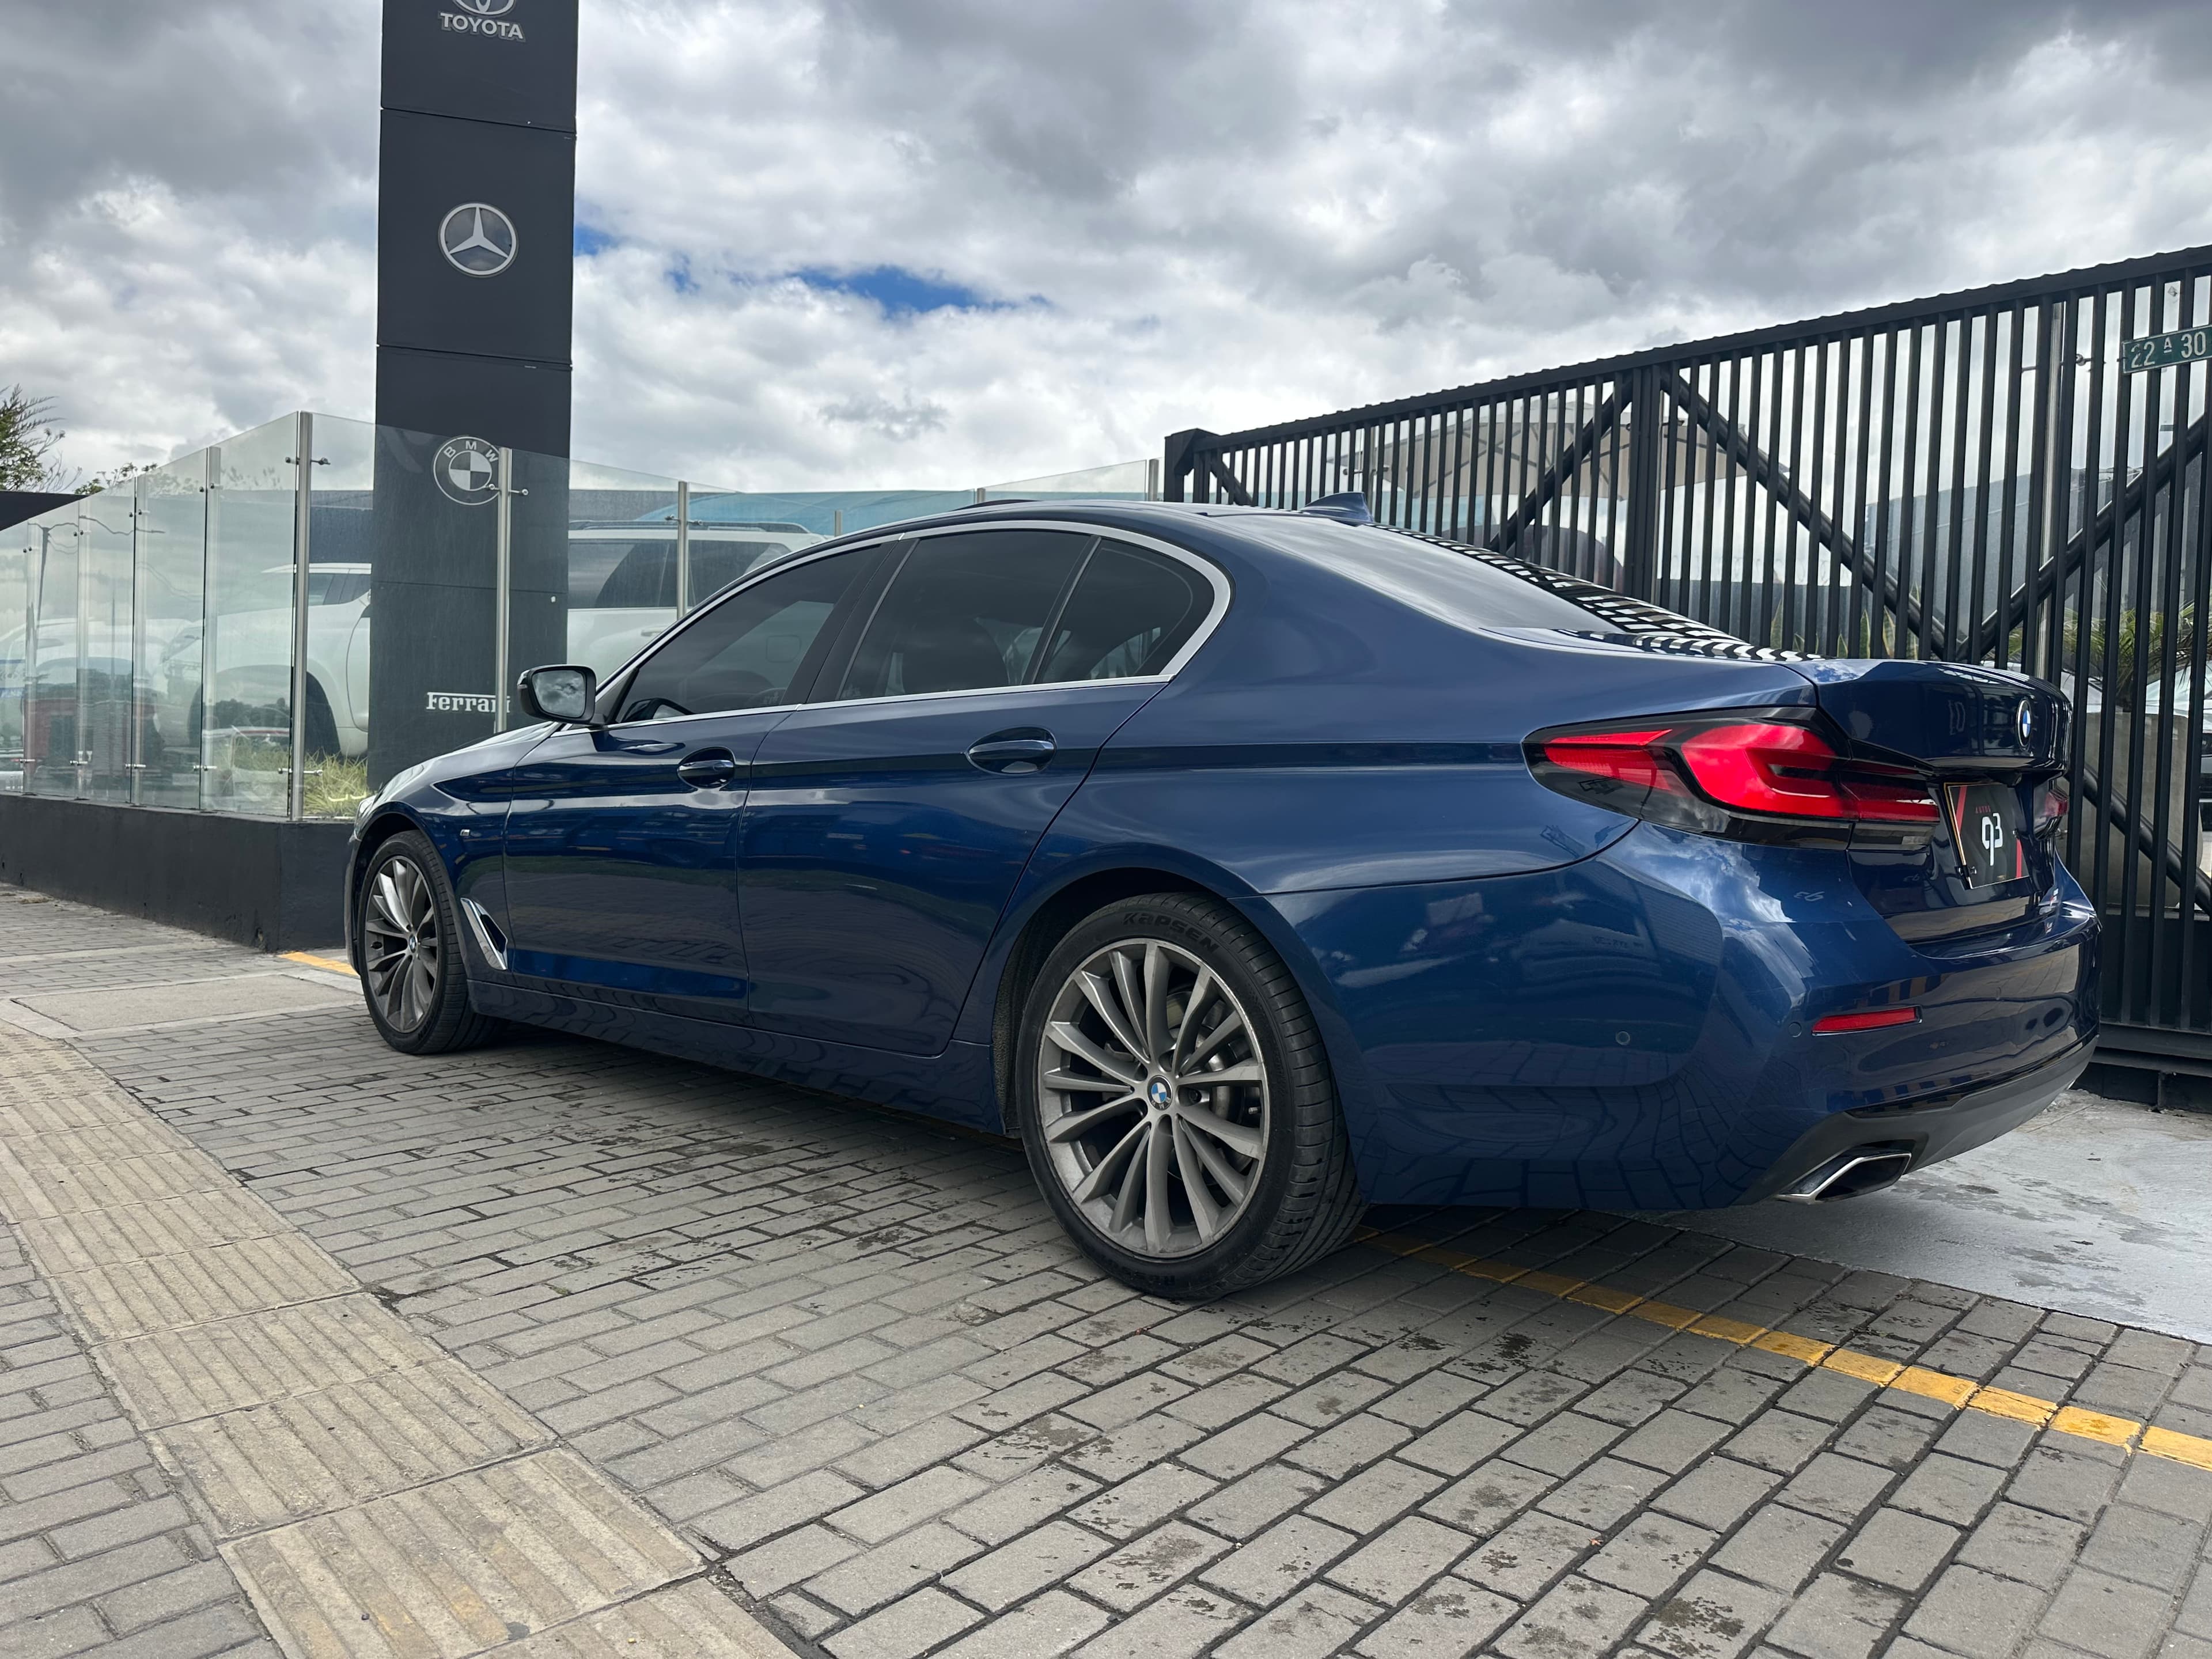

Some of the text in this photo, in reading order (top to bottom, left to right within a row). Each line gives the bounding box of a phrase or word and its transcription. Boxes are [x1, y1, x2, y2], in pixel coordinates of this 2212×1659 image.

[440, 12, 524, 40] TOYOTA
[2131, 331, 2206, 368] 22 A 30
[444, 441, 498, 463] BMW
